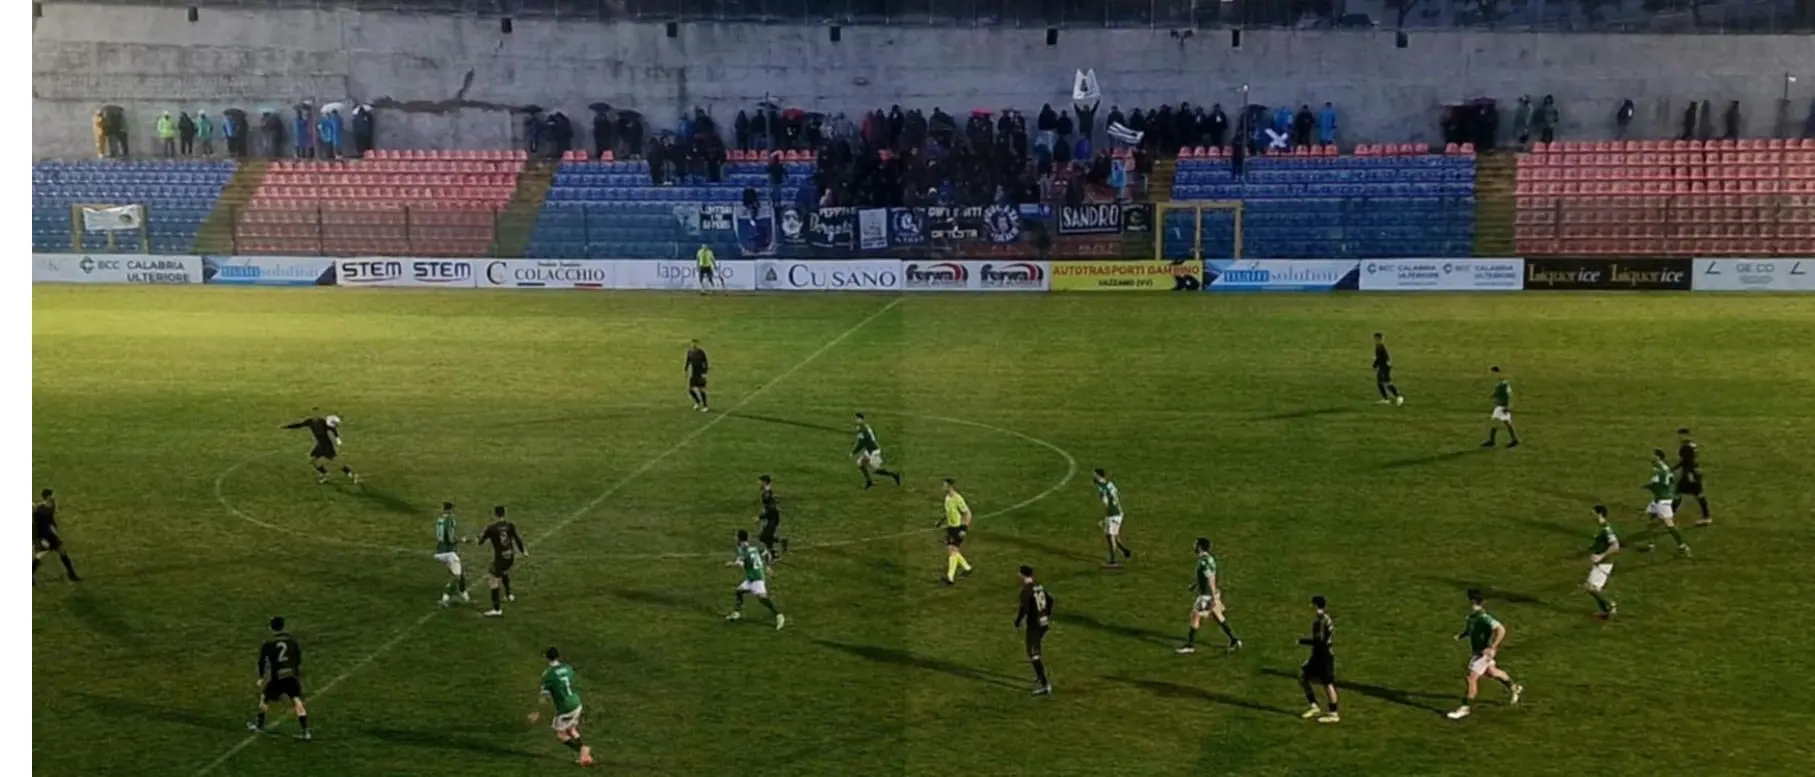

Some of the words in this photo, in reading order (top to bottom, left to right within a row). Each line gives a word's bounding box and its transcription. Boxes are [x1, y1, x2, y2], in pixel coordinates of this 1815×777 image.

[1063, 204, 1119, 228] SANDRO
[127, 260, 185, 270] CALABRIA
[342, 262, 402, 277] STEM
[413, 262, 471, 277] STEM
[1053, 266, 1144, 275] AUTOTRASPORTI
[1148, 266, 1200, 275] GAMBINO
[127, 272, 189, 283] ULTERIORE
[487, 261, 507, 285] C
[514, 268, 605, 281] COLACCHIO
[276, 641, 288, 662] 2
[560, 676, 573, 696] 7
